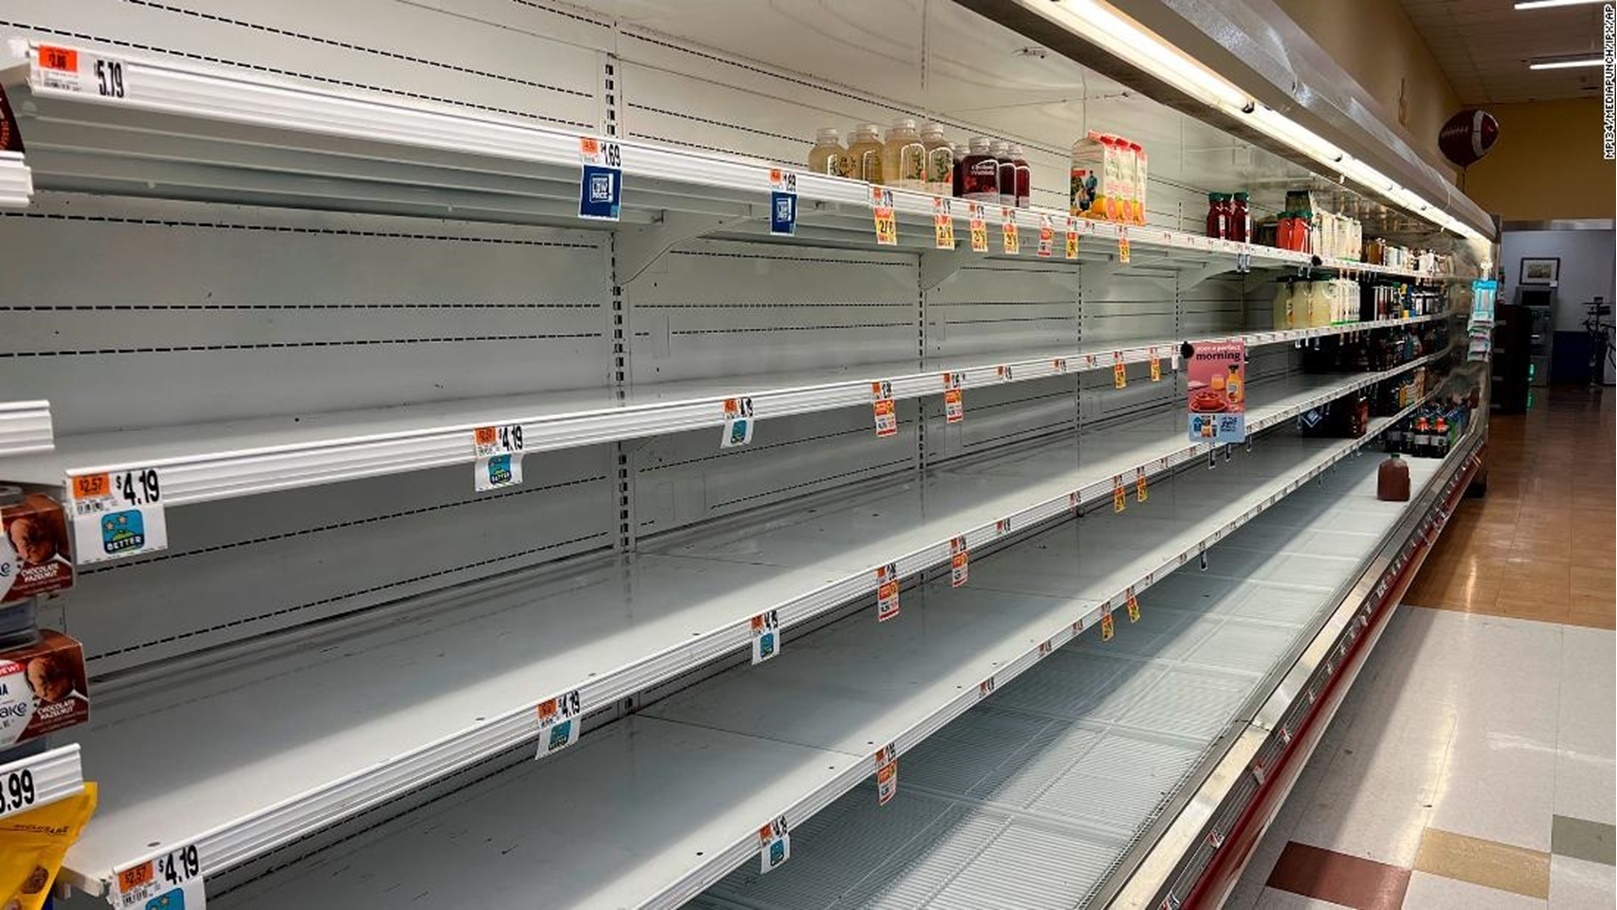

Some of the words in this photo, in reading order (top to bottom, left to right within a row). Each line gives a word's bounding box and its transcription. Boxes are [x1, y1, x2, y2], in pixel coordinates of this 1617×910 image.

[1196, 350, 1242, 362] morning
[116, 469, 160, 506] $4.19
[106, 535, 142, 551] BETTER
[21, 562, 59, 578] CHOCOLATE
[37, 699, 75, 716] CHOCOLATE
[159, 844, 199, 885] $4.19
